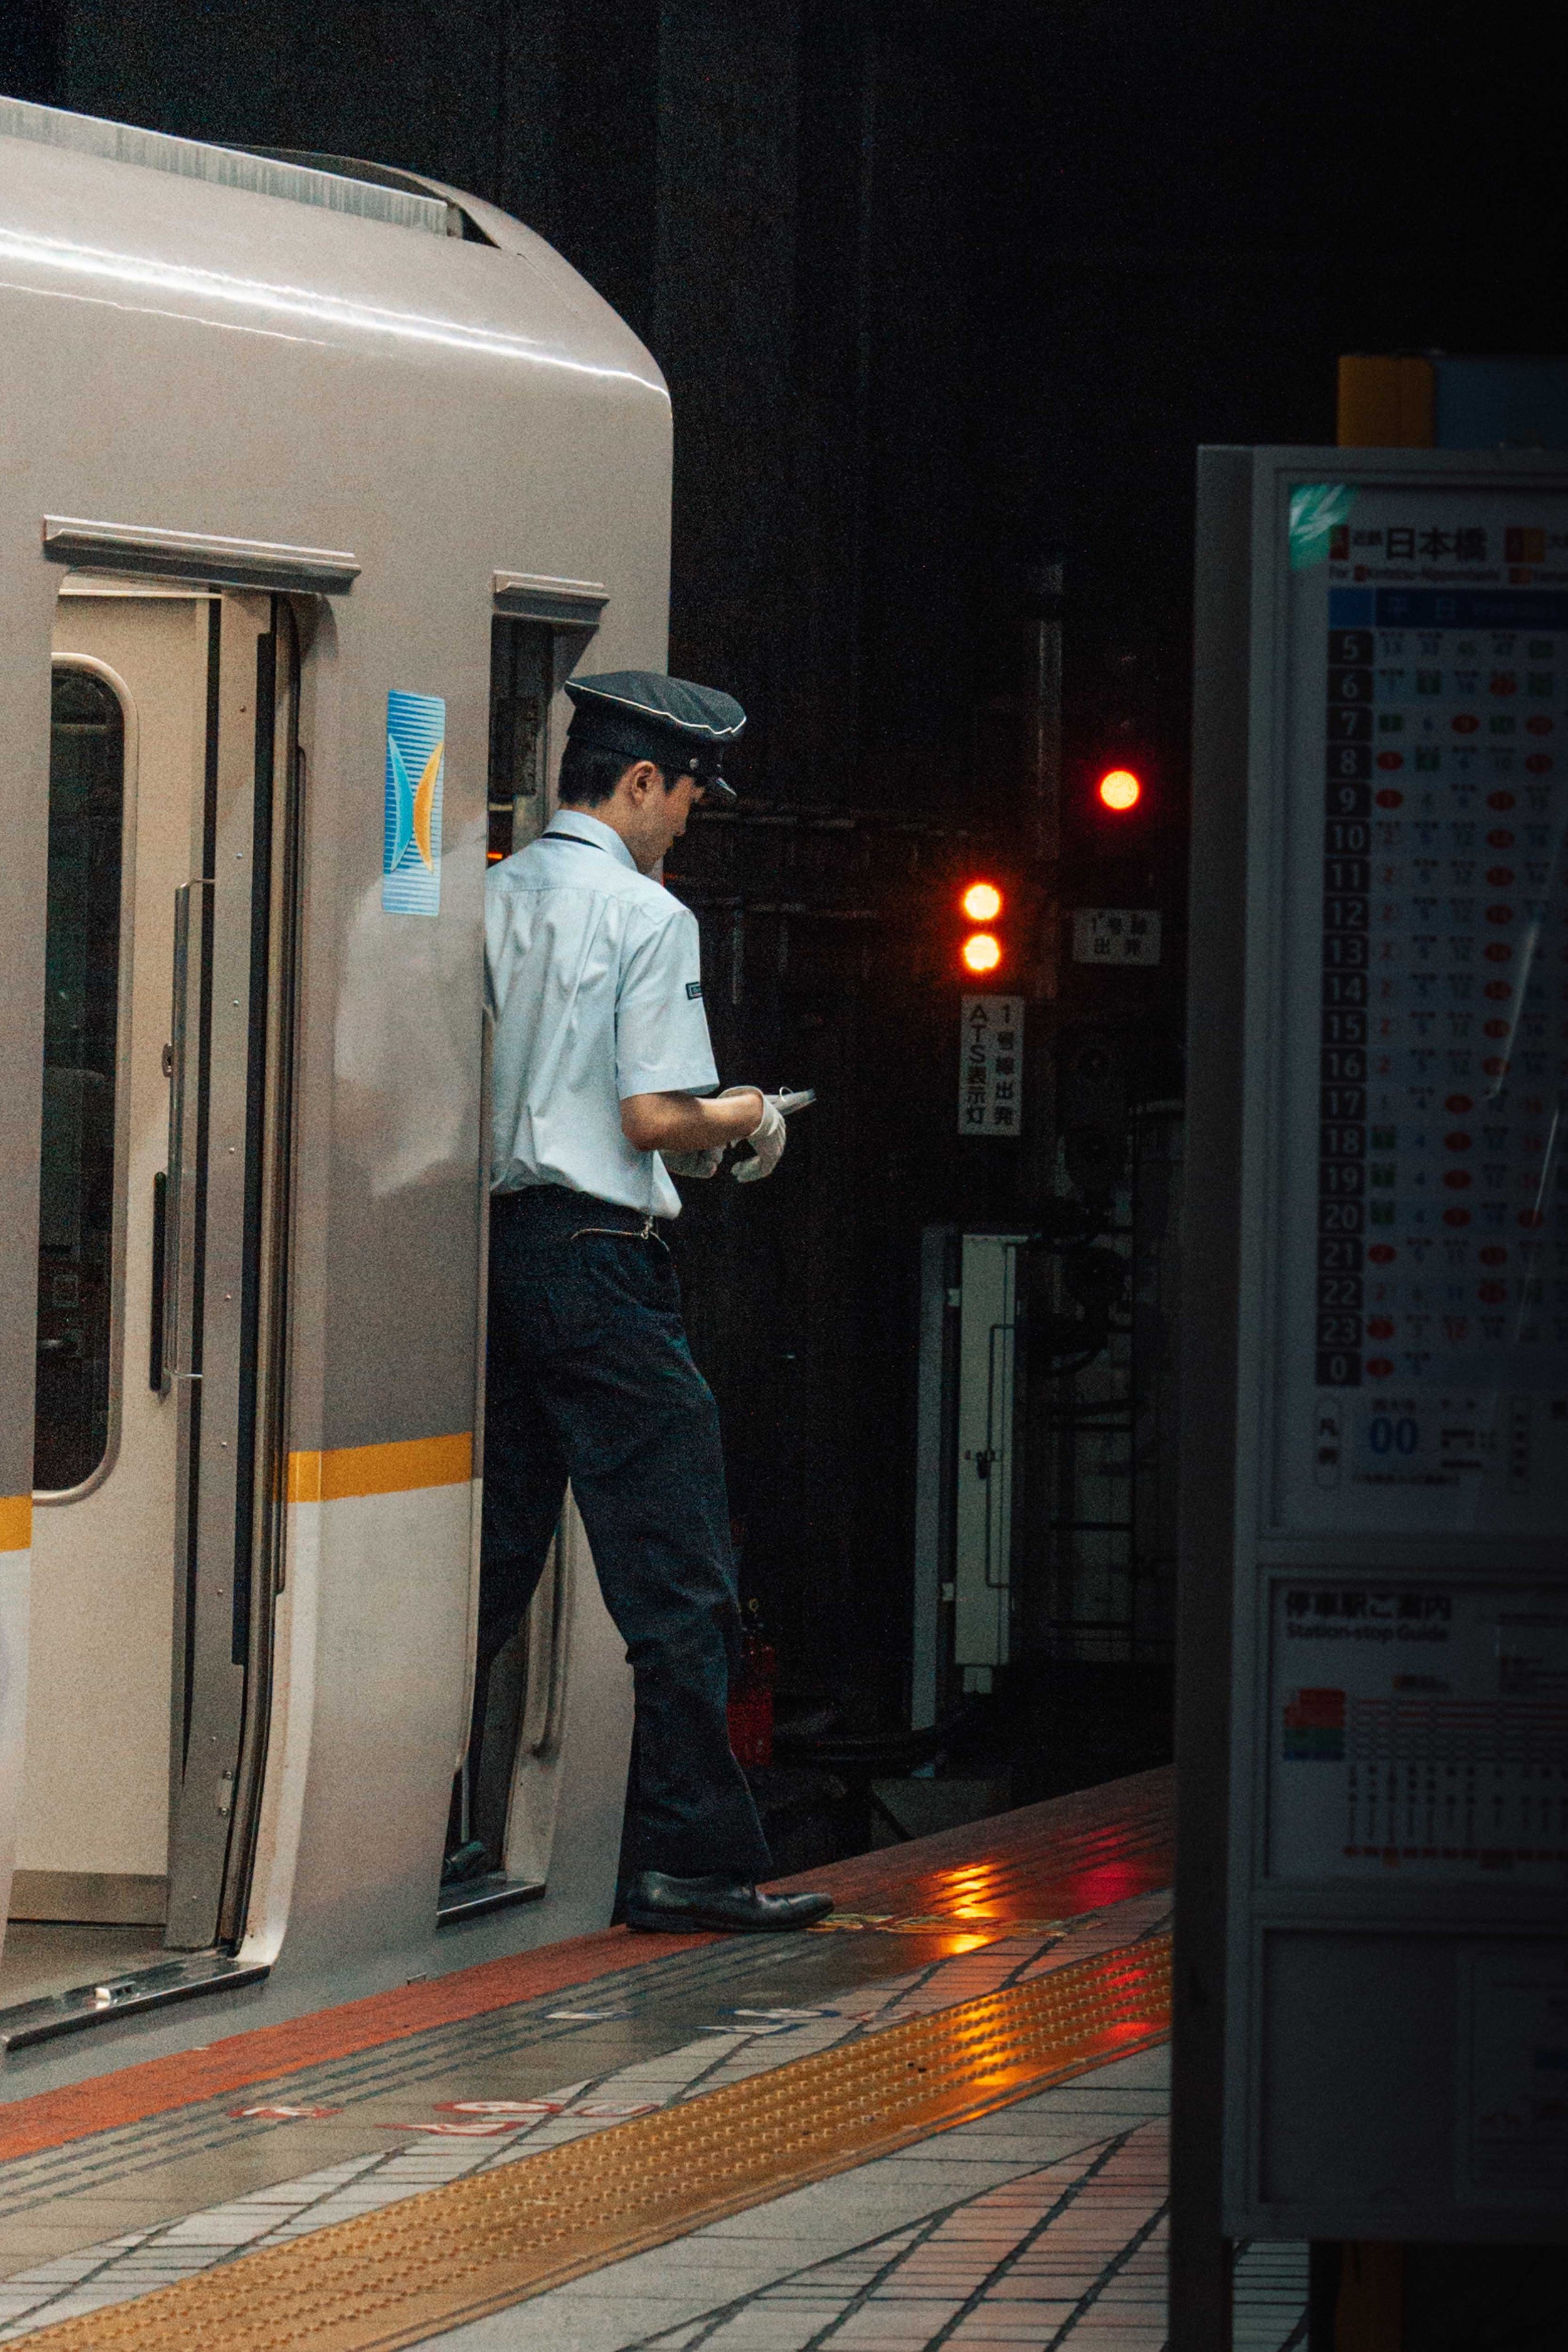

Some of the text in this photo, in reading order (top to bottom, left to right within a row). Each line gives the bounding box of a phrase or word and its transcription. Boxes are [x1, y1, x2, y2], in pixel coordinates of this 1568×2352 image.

[1387, 526, 1487, 561] 日本橋
[1342, 633, 1360, 662] 5
[1340, 673, 1360, 699] 6
[1340, 709, 1359, 736] 7
[1339, 748, 1358, 775] 8
[1338, 786, 1357, 813] 9
[1333, 824, 1365, 851] 10
[1331, 862, 1362, 888] 11
[1332, 900, 1364, 927] 12
[1330, 938, 1364, 965] 13
[1330, 976, 1362, 1002] 14
[1330, 1014, 1361, 1041] 15
[966, 1004, 988, 1125] ATS表示灯
[1328, 1052, 1361, 1078] 16
[1328, 1089, 1361, 1116] 17
[1328, 1128, 1360, 1154] 18
[1327, 1165, 1359, 1192] 19
[1324, 1203, 1359, 1230] 20
[1323, 1240, 1355, 1268] 21
[1322, 1278, 1357, 1306] 22
[1322, 1316, 1357, 1344] 23
[1328, 1353, 1348, 1382] 0
[1369, 1416, 1419, 1455] 00
[1286, 1592, 1451, 1619] 停車駅ご案内
[1286, 1623, 1449, 1643] Station-stop Guide
